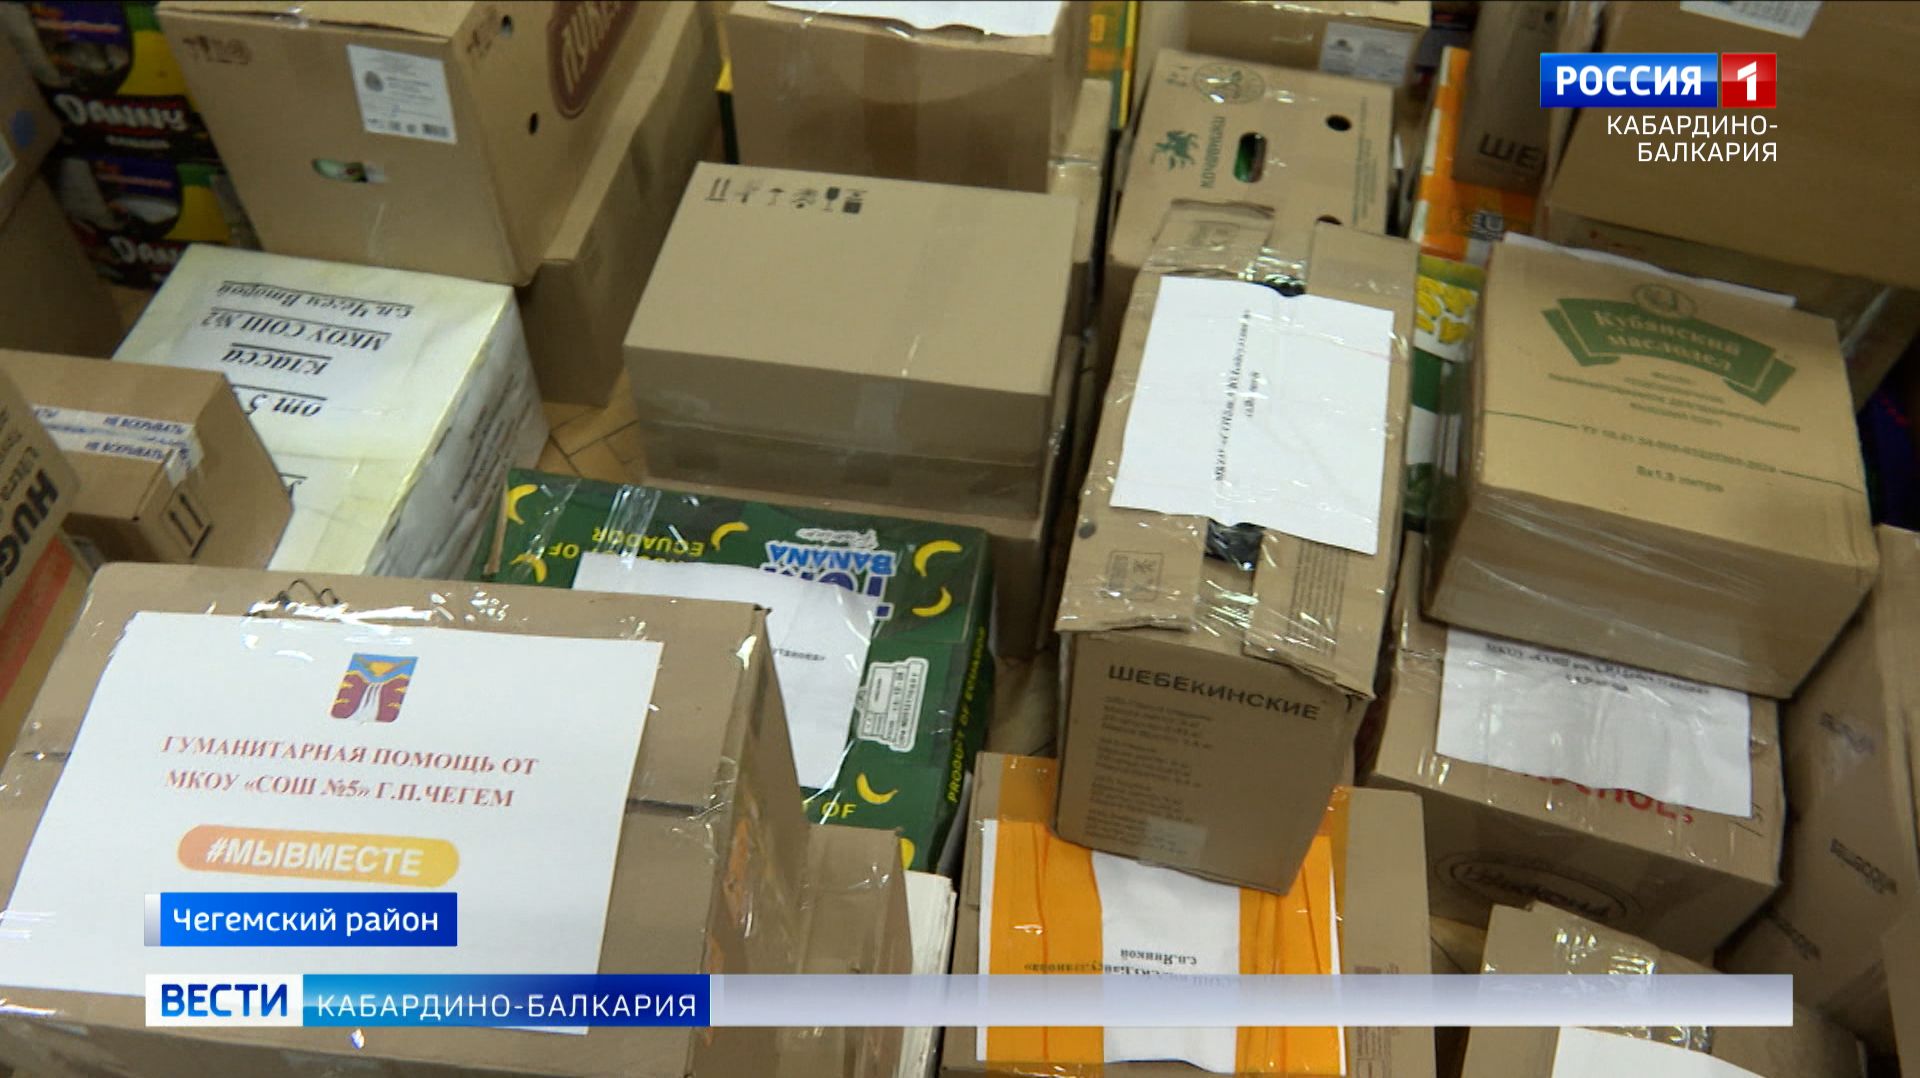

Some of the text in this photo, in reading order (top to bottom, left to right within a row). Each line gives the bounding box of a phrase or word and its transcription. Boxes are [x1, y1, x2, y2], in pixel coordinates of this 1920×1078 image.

[240, 315, 305, 338] СОШ
[309, 328, 387, 351] МКОУ
[1594, 310, 1740, 356] Кубанский
[245, 393, 322, 417] от 5
[547, 542, 579, 559] OF
[591, 526, 705, 557] ECUADOR
[767, 542, 895, 576] BANANA
[1107, 664, 1322, 721] ШЕБЕКИНСКИЕ
[161, 735, 540, 776] ГУМАНИТАРНАЯ ПОМОЩЬ ОТ
[165, 769, 515, 808] МКОУ «СОШ №5» Г.П.ЧЕГЕМ
[820, 801, 857, 819] OF
[205, 836, 425, 877] #МЫВМЕСТЕ
